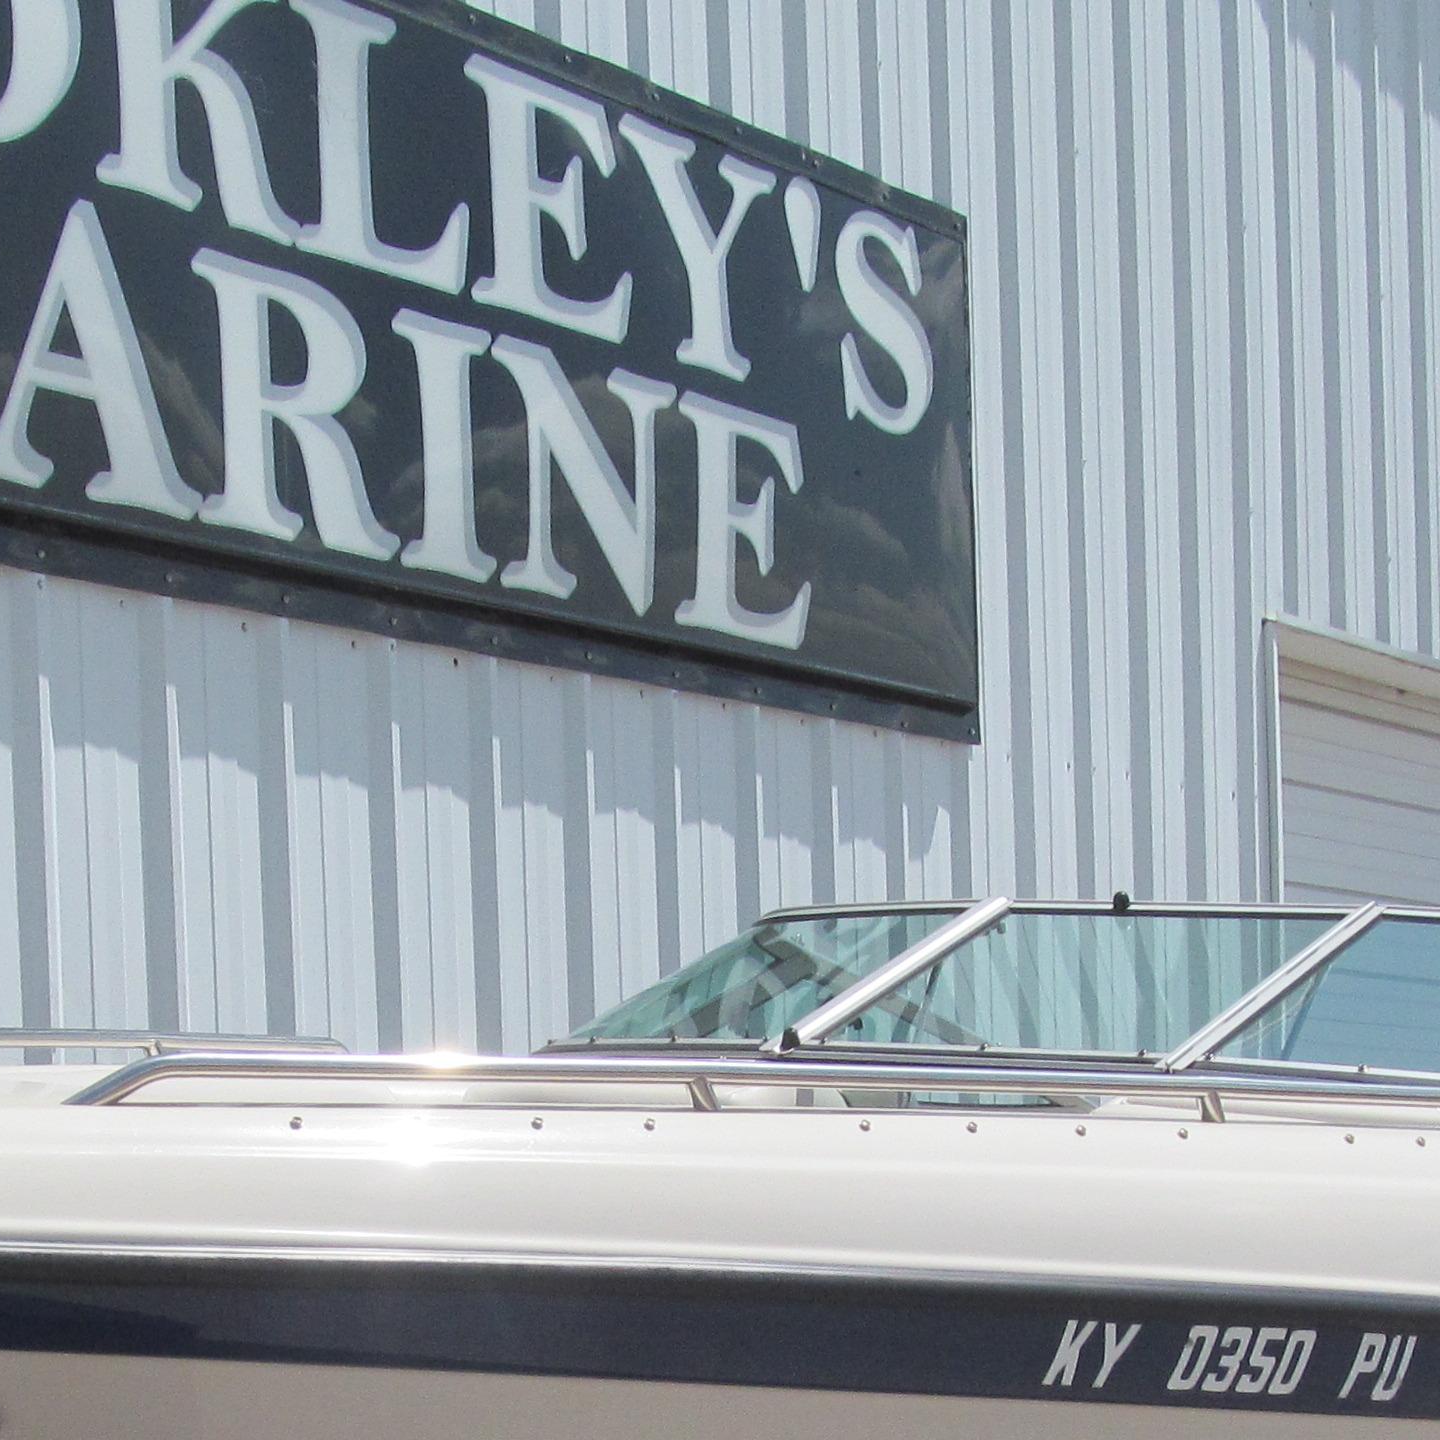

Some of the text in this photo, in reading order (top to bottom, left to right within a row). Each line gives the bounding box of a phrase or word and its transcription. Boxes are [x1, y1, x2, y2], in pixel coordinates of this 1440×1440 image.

[1041, 1319, 1418, 1401] KY 0350 PU
